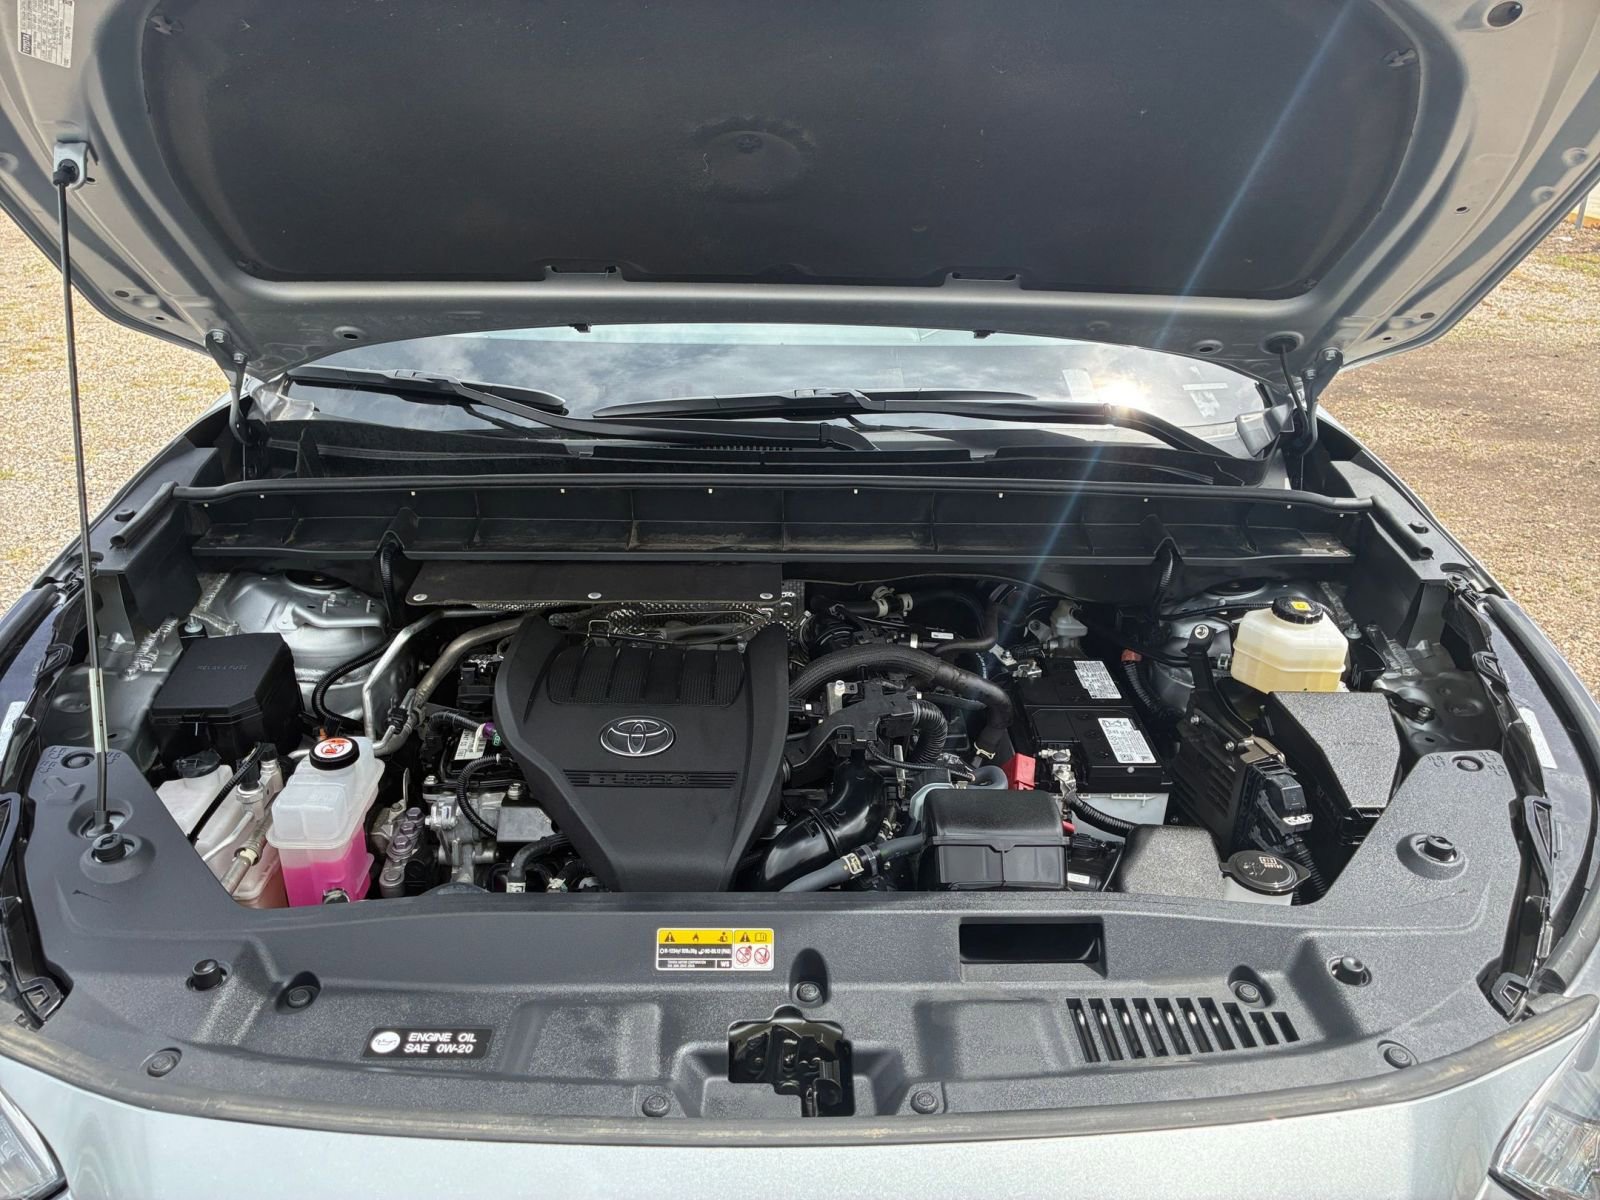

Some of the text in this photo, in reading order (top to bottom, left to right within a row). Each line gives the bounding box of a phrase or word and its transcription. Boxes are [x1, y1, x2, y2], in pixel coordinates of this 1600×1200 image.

[408, 1032, 478, 1042] ENGINE OIL
[404, 1043, 474, 1054] SAE 0W-20
